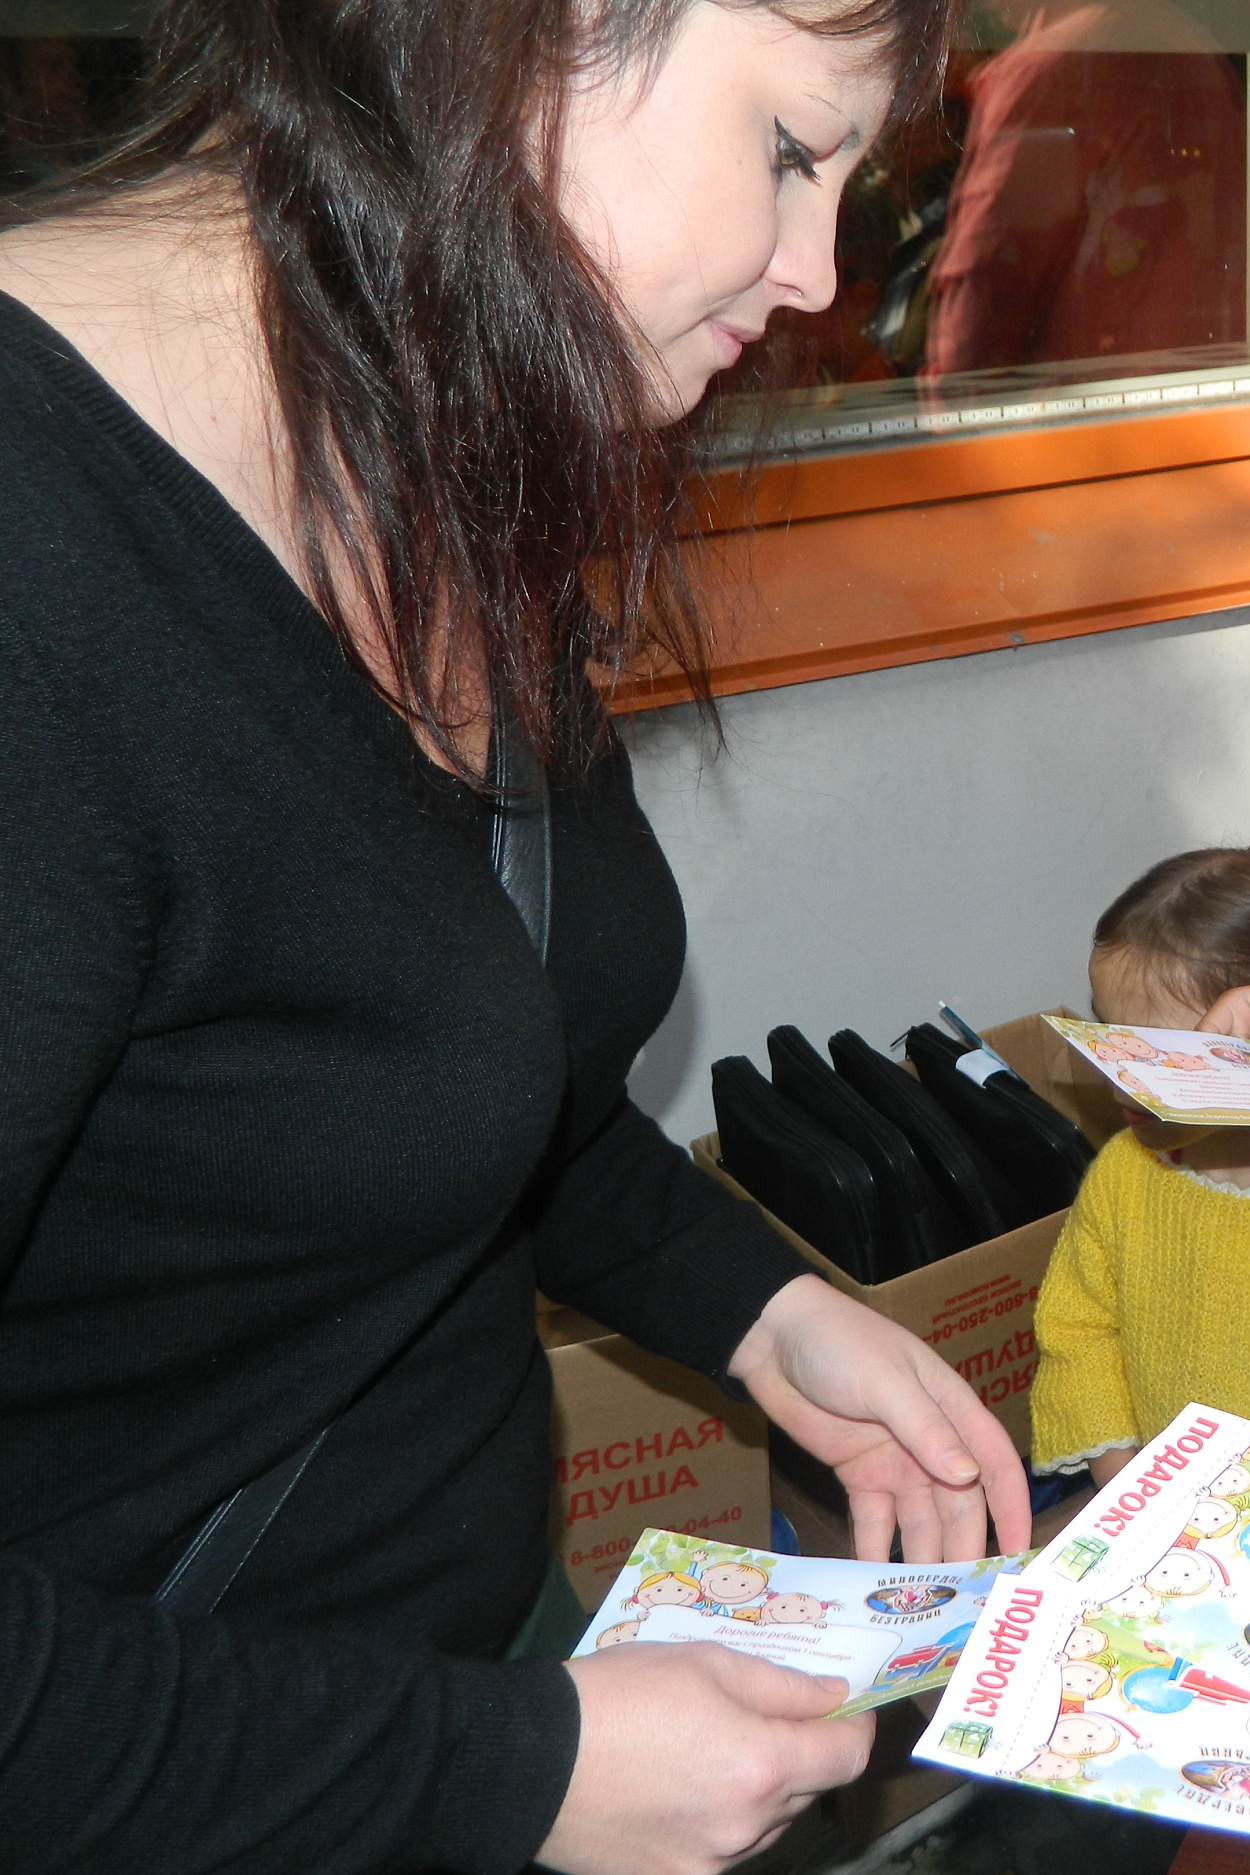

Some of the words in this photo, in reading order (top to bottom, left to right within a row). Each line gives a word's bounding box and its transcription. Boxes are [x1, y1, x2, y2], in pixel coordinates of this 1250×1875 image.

[566, 1465, 699, 1526] ДУША
[1094, 1417, 1220, 1538] ПОДАРОК!
[713, 1625, 767, 1637] Дорогие
[766, 1631, 823, 1645] ребята!
[963, 1587, 1044, 1718] ПОДАРОК!
